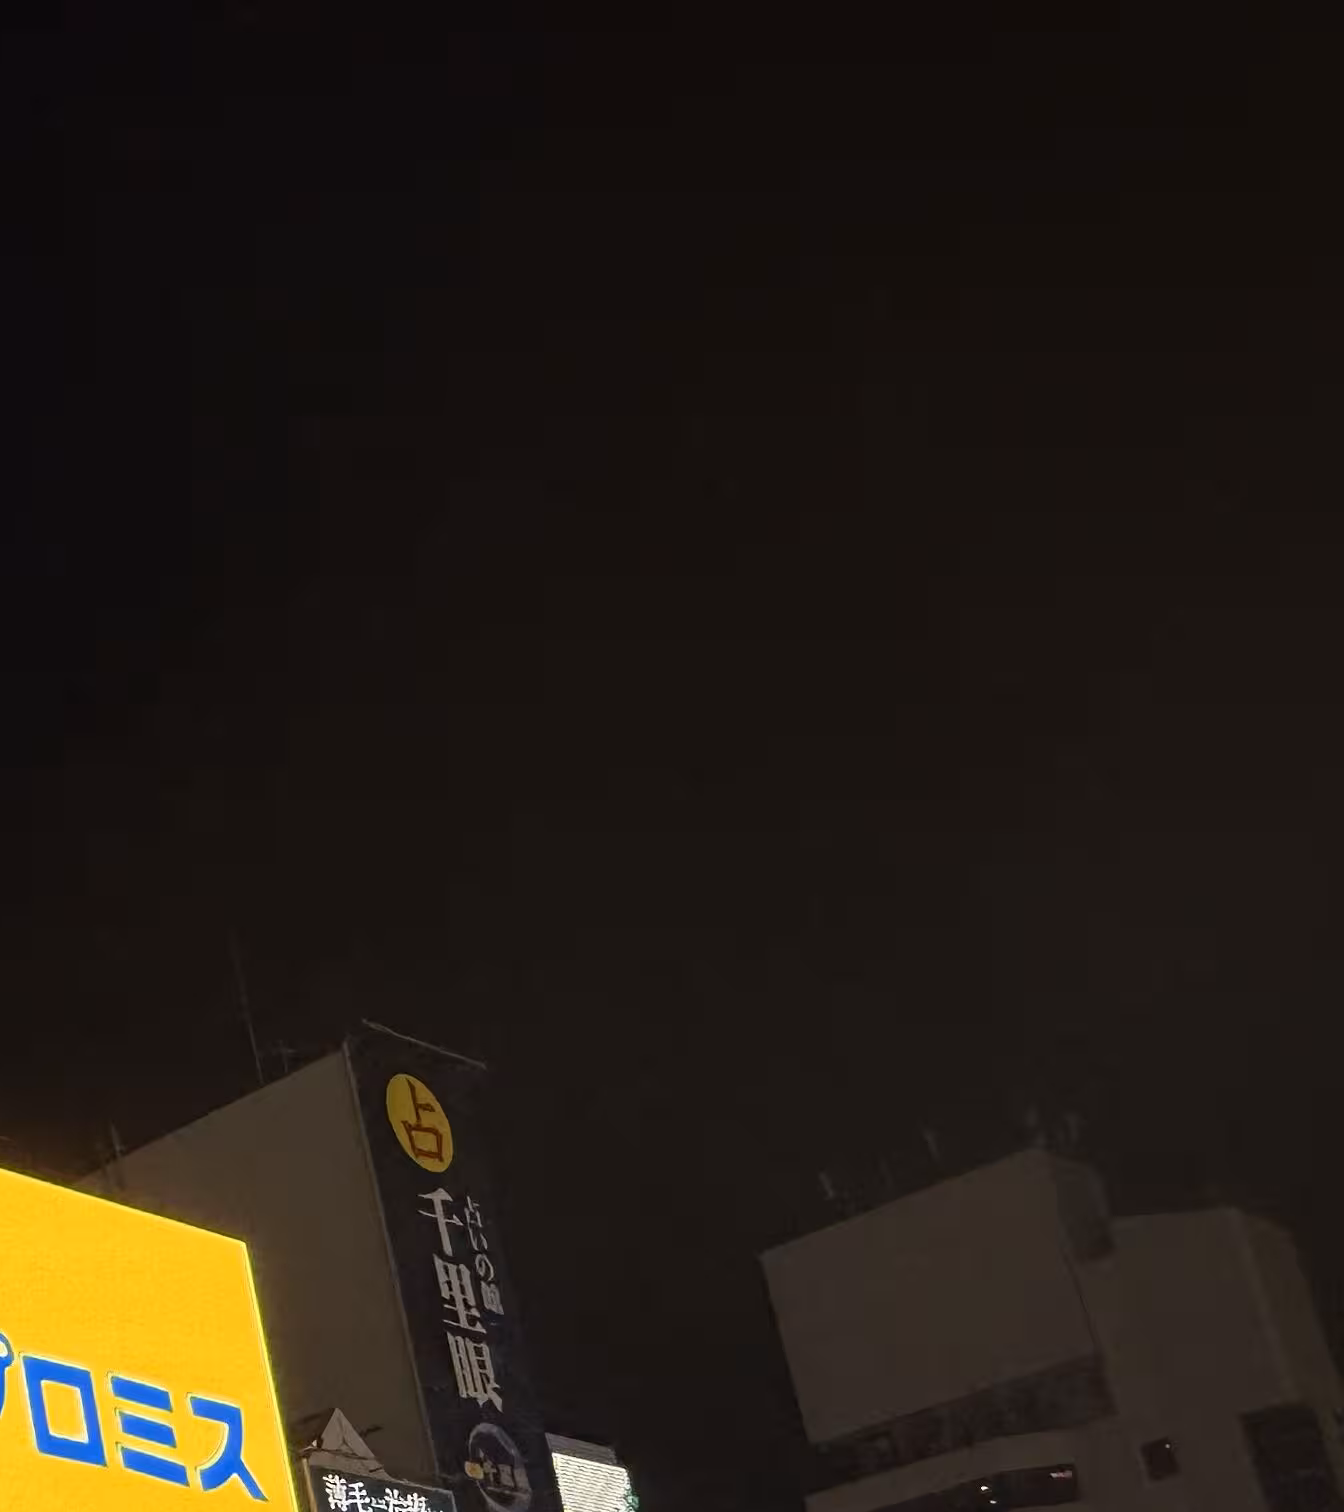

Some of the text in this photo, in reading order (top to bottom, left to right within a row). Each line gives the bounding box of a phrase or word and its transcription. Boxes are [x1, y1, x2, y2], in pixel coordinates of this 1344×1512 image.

[401, 1077, 445, 1163] 占
[417, 1187, 504, 1413] 千里眼
